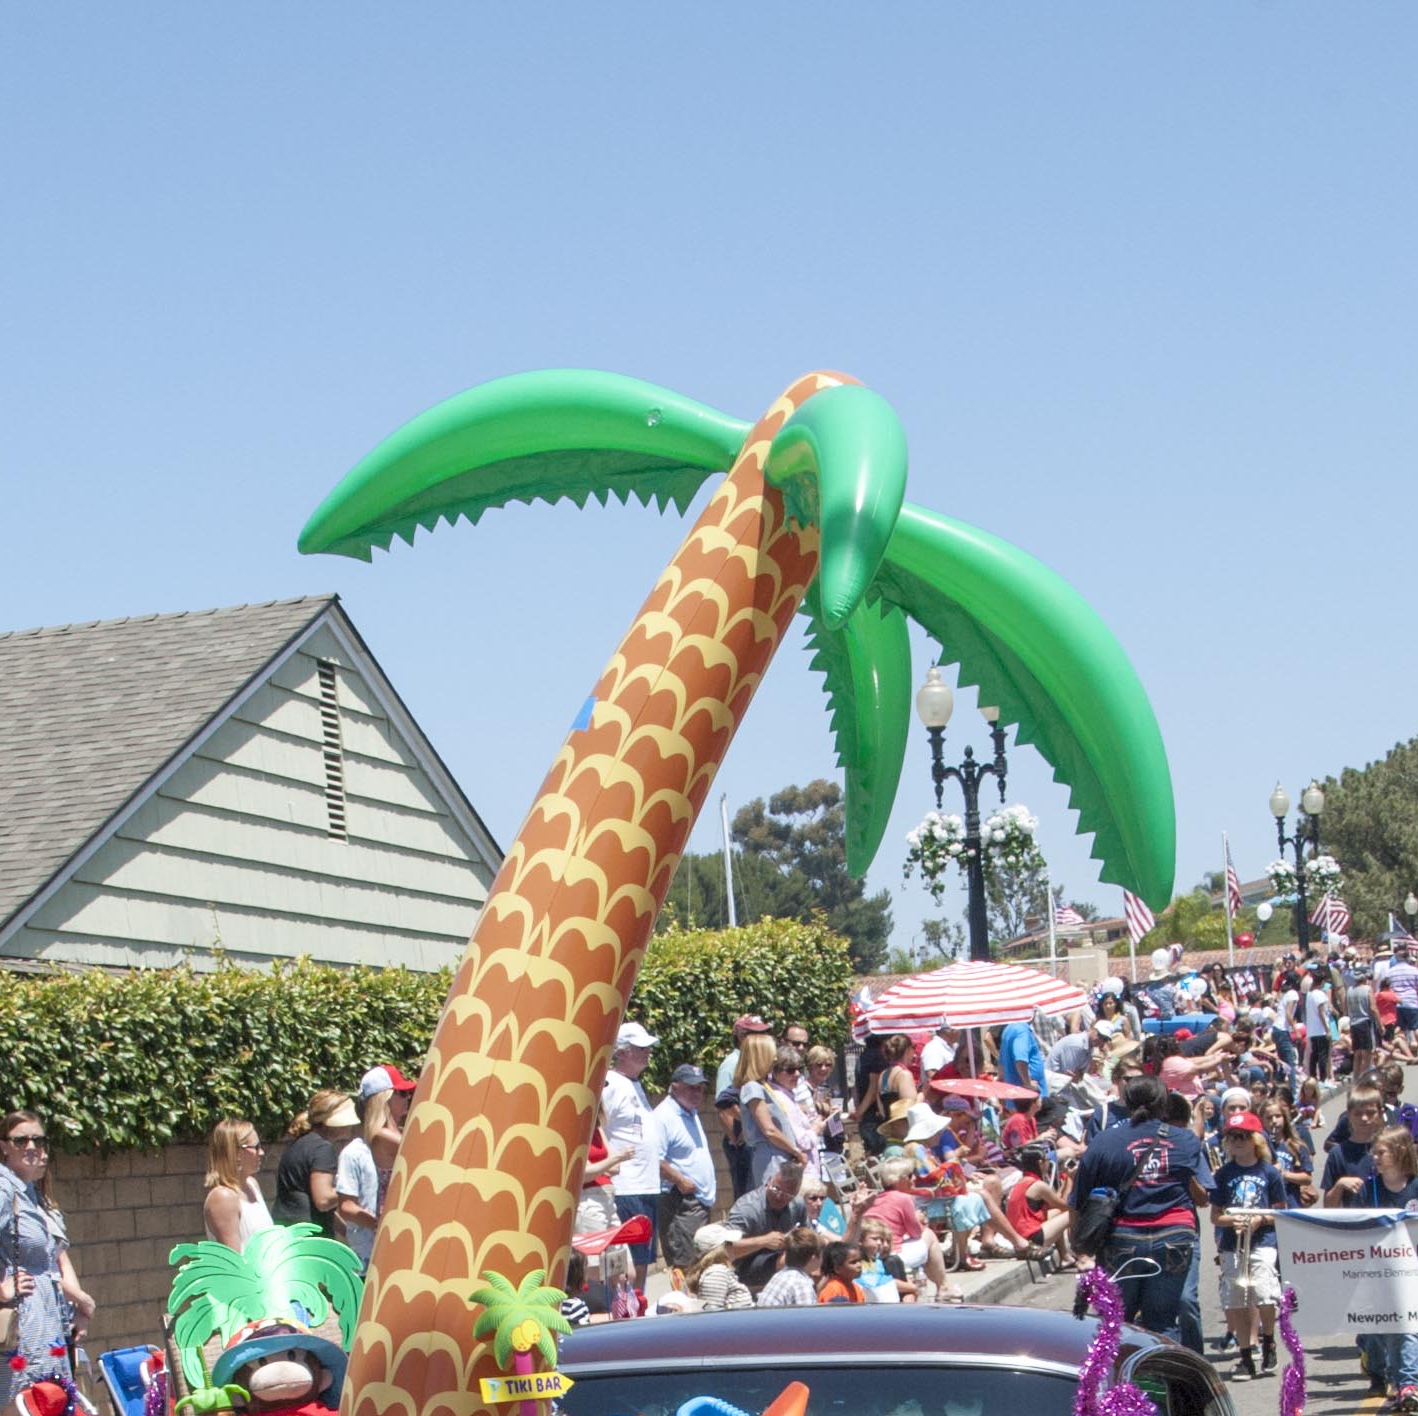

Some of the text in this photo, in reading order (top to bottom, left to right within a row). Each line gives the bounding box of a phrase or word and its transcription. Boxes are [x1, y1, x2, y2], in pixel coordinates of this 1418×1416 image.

[1292, 1248, 1366, 1264] Mariners
[1369, 1244, 1413, 1259] Music
[1342, 1269, 1382, 1280] Mariners
[1347, 1312, 1404, 1324] Newport-
[505, 1376, 563, 1395] TIKI BAR
